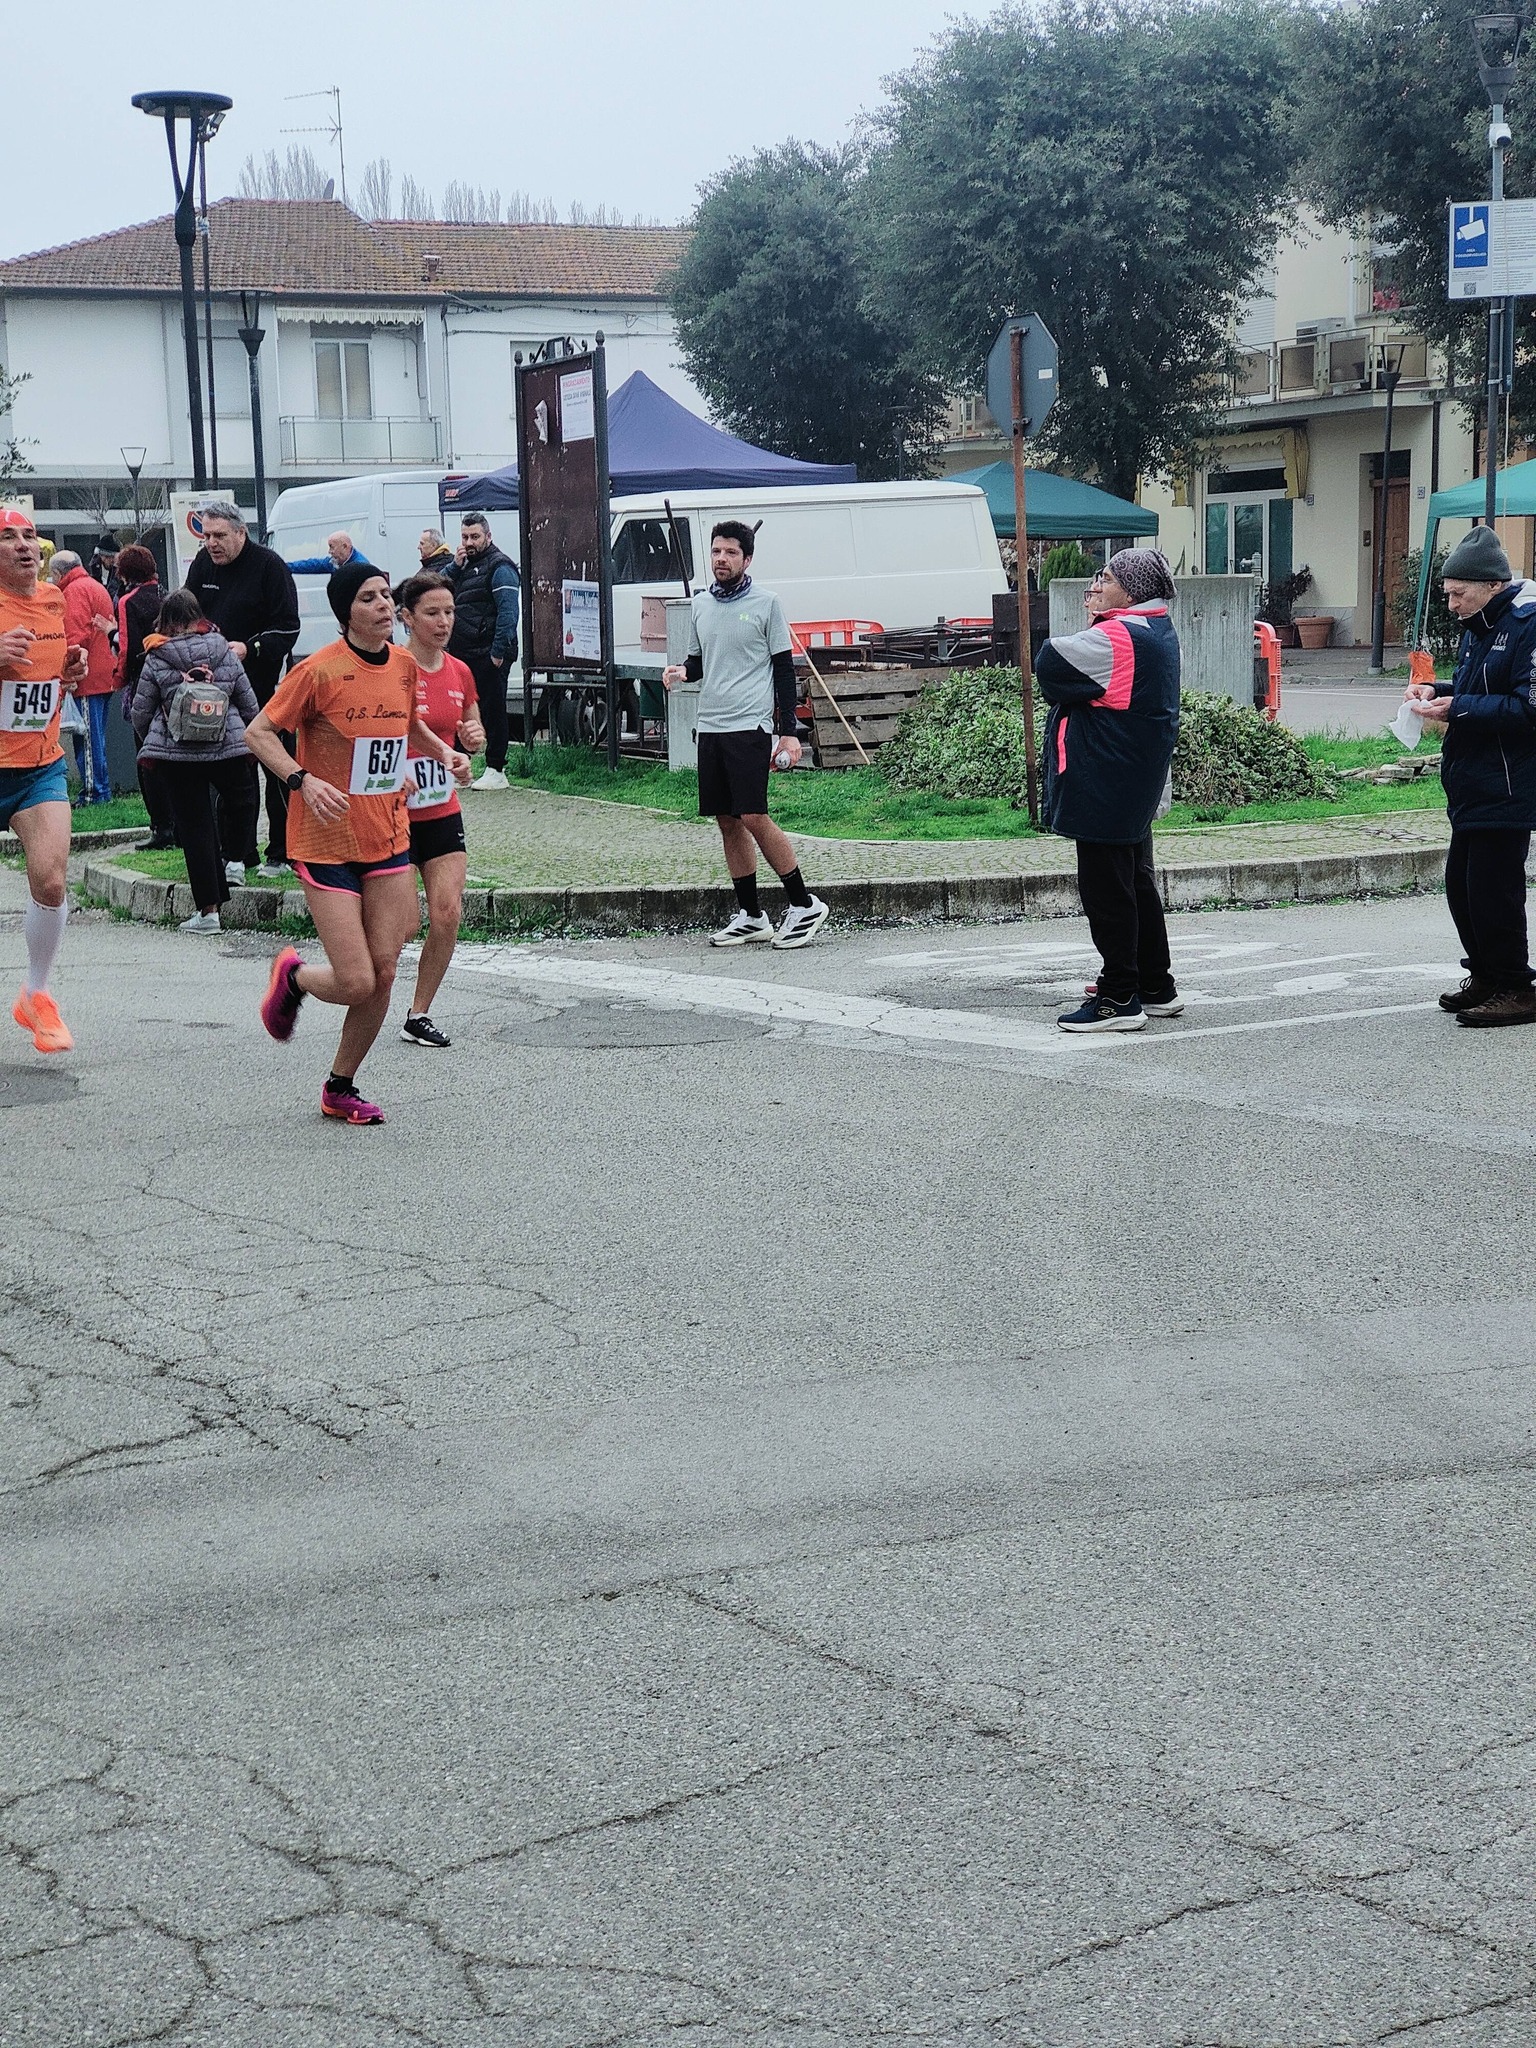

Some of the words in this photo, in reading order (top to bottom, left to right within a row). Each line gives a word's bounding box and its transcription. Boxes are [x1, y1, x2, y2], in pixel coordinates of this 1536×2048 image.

[13, 683, 52, 714] 549
[368, 739, 403, 775] 637
[415, 759, 446, 789] 675
